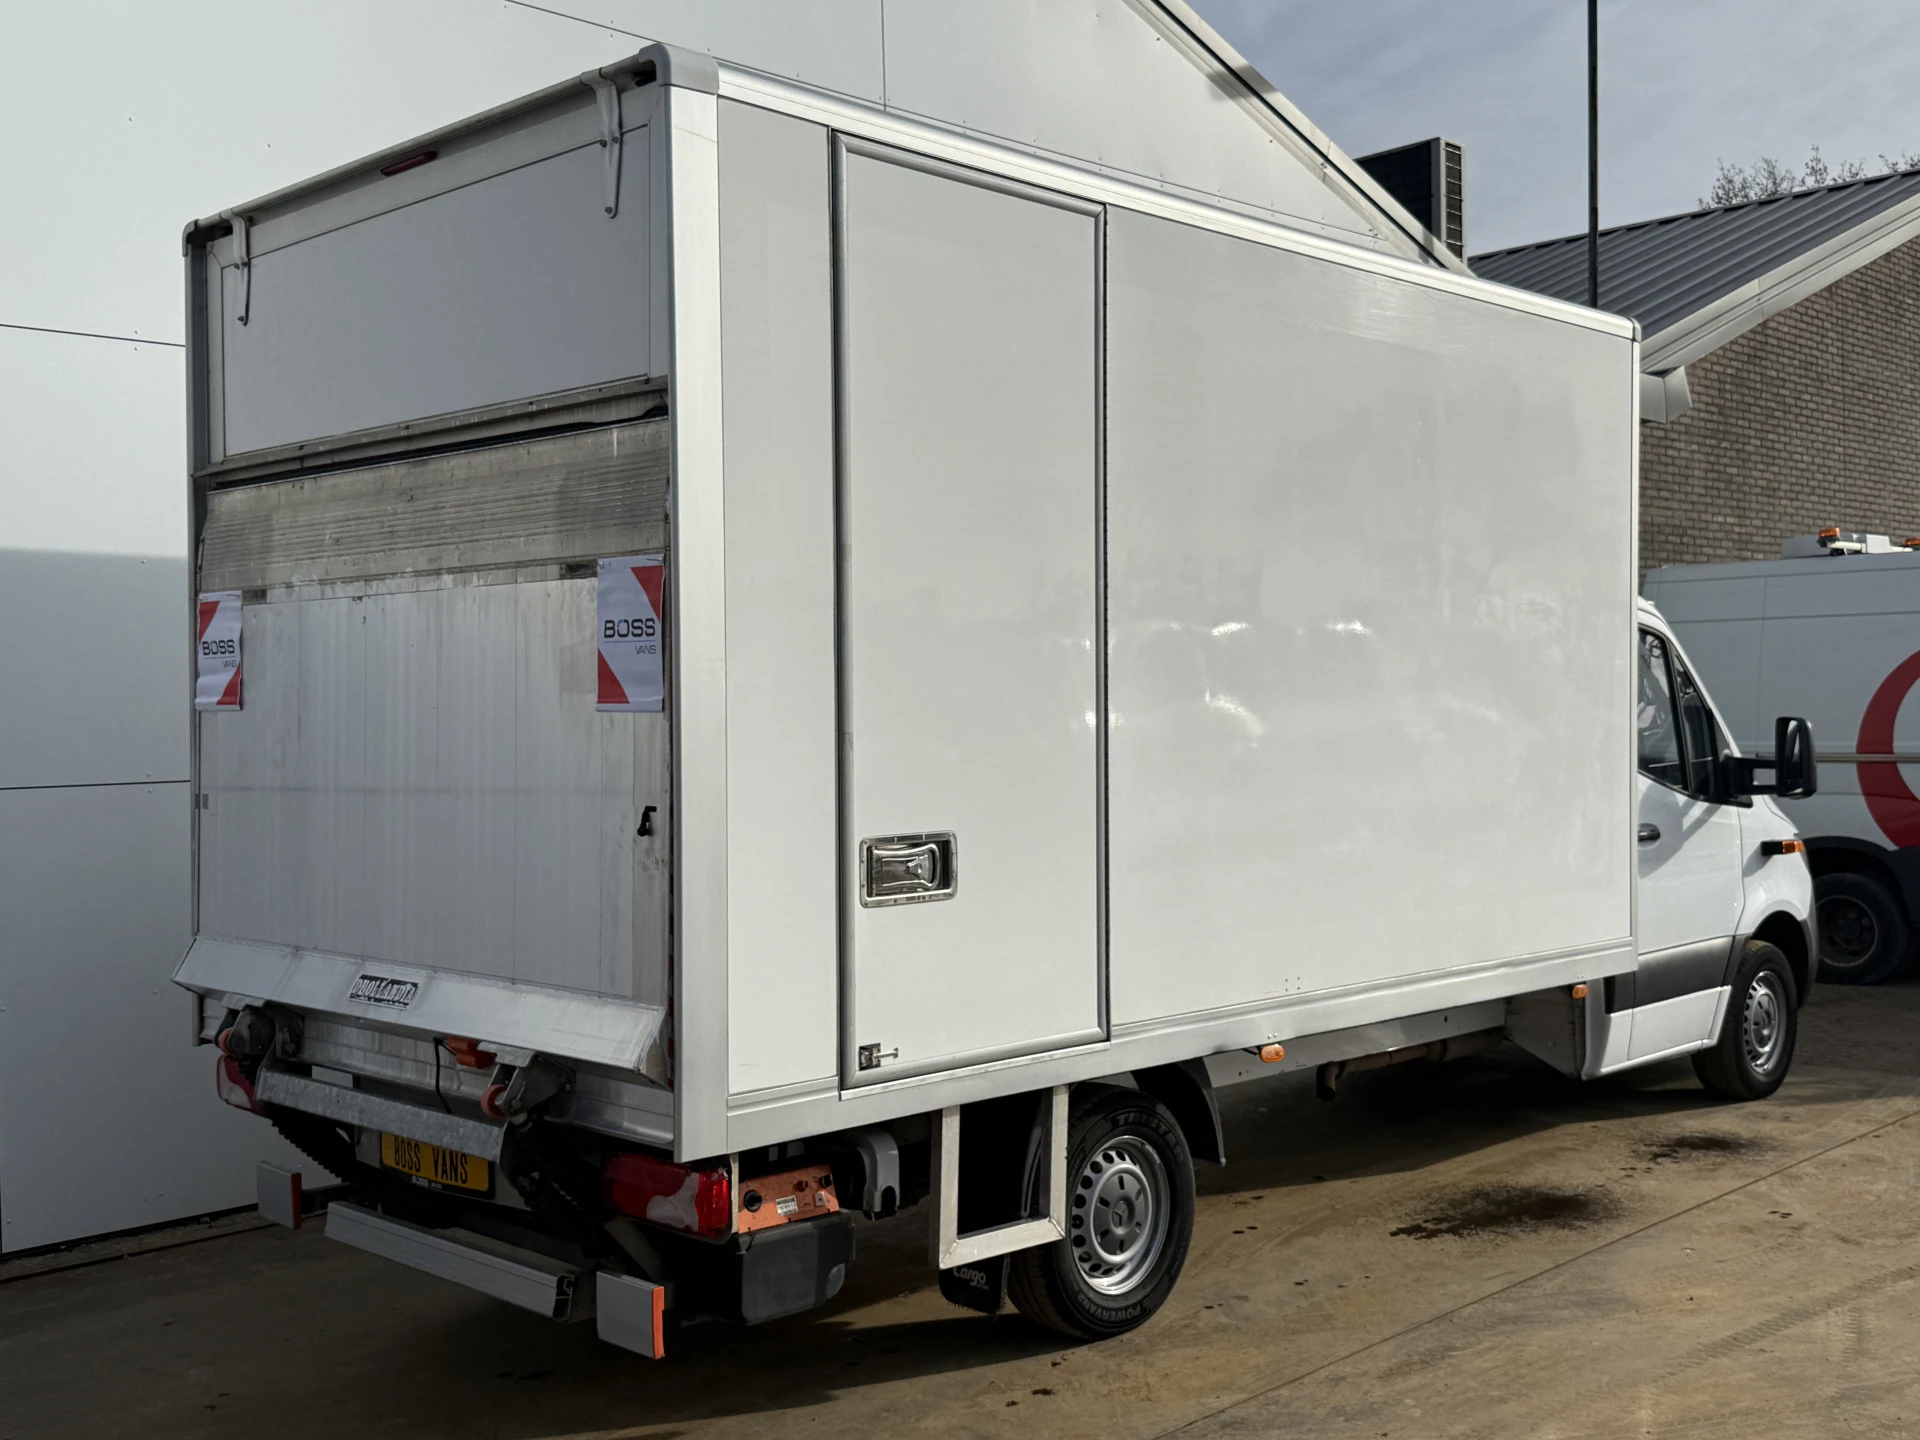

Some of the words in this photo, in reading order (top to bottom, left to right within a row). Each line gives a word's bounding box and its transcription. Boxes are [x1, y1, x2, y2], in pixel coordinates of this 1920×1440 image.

[603, 617, 656, 638] BOSS
[202, 639, 236, 656] BOSS
[634, 644, 657, 655] VANS
[394, 1135, 421, 1174] BOSS
[432, 1147, 469, 1185] VANS
